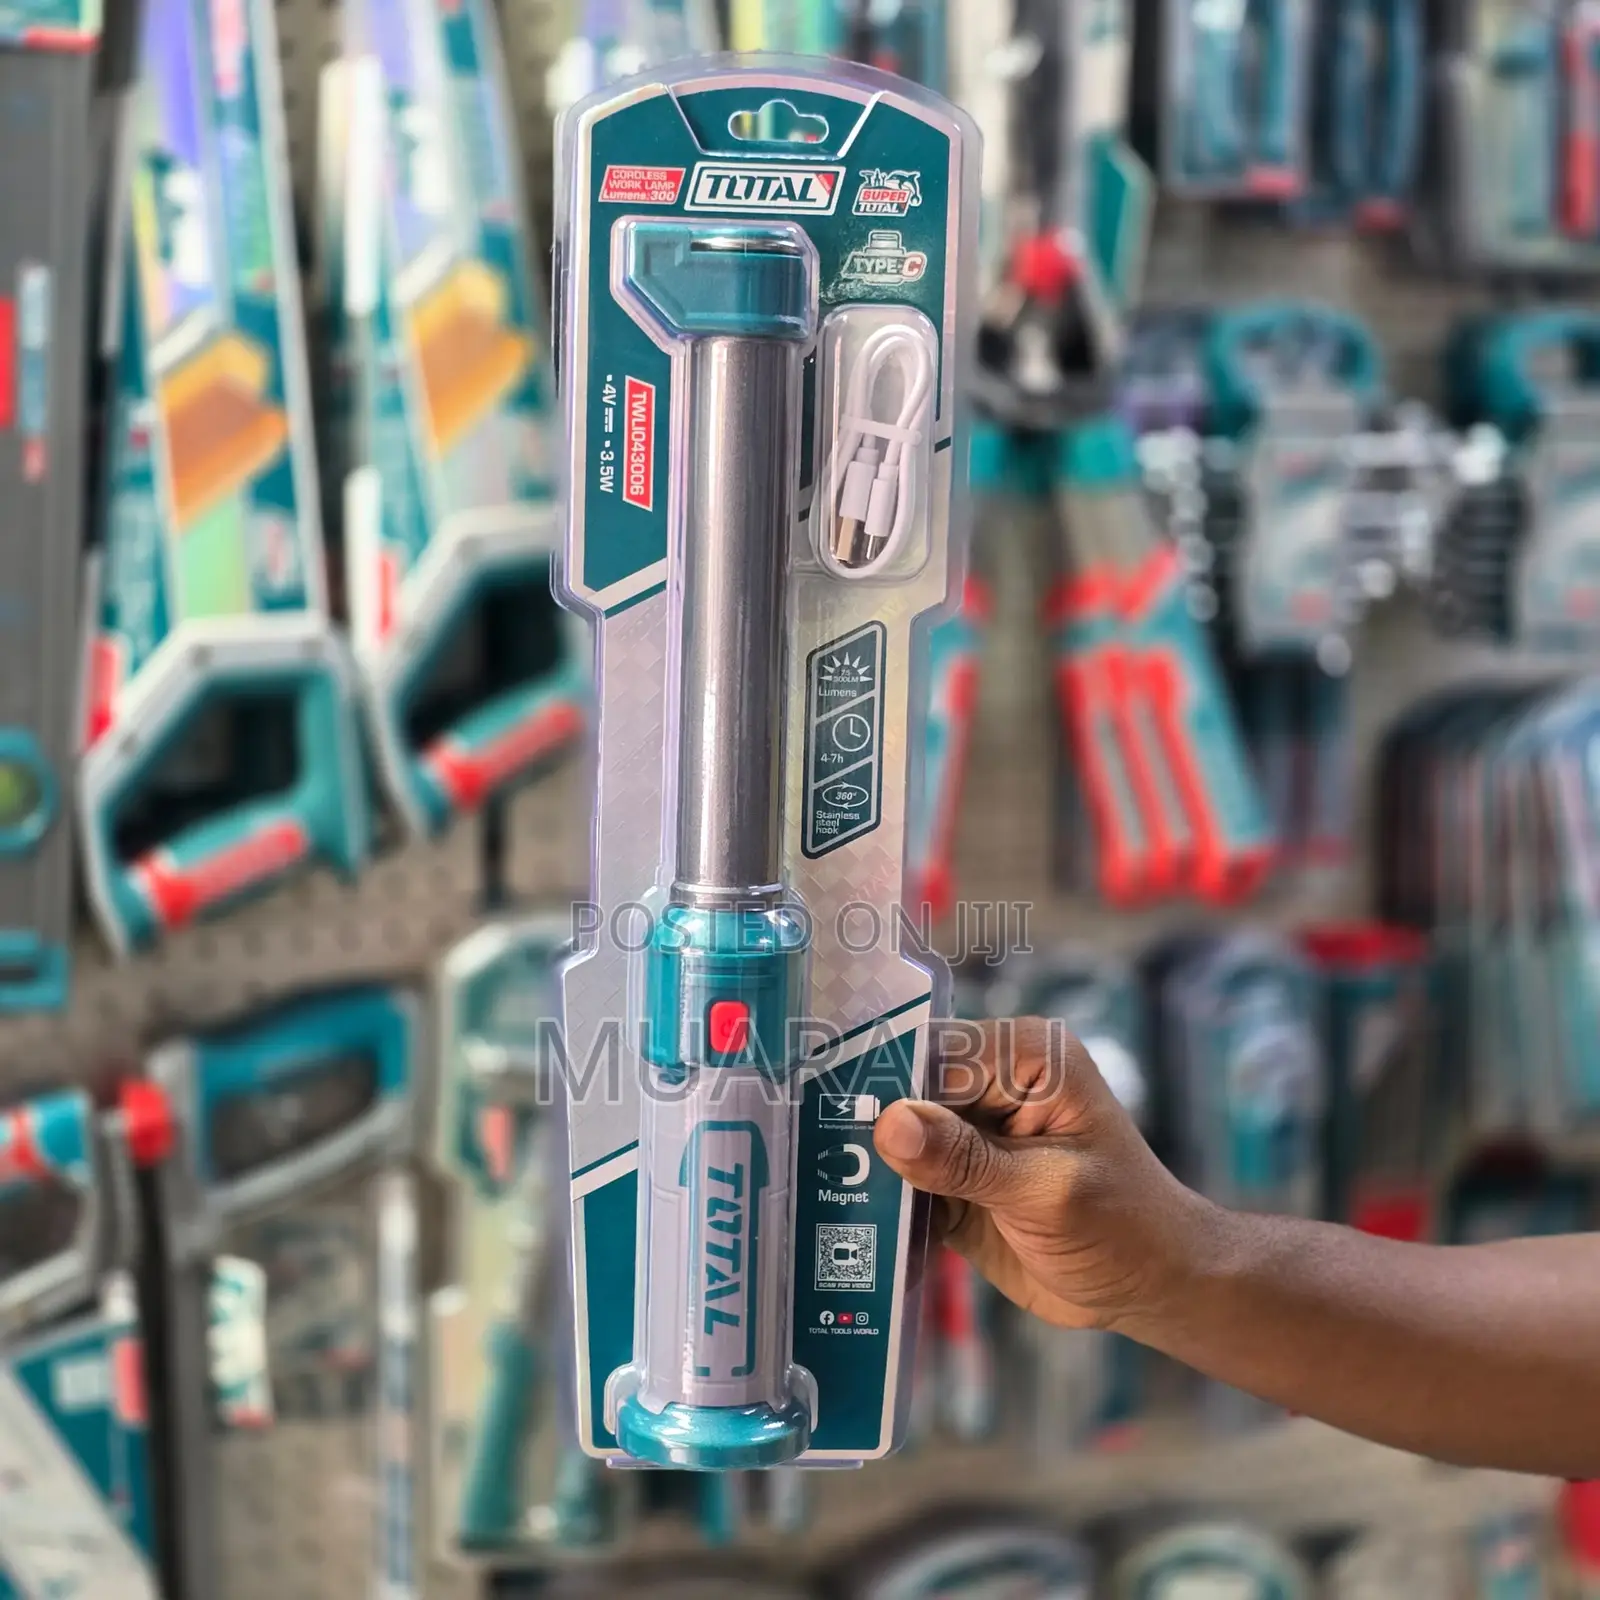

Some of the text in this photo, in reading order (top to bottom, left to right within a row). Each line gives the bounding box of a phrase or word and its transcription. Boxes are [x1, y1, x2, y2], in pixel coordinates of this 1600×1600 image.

[612, 169, 668, 181] CORDLESS
[609, 179, 676, 191] WORK LAMP
[706, 174, 818, 202] TOTAL
[861, 189, 908, 202] SUPER
[859, 202, 900, 213] TOTAL
[853, 255, 923, 277] TYPE-C
[599, 450, 615, 494] 3.5W
[818, 685, 858, 697] Lumens
[820, 753, 844, 764] 4-7h
[815, 810, 860, 821] Stainless
[815, 819, 840, 828] steel
[815, 826, 839, 835] hook
[818, 1188, 870, 1206] Magnet
[703, 1162, 745, 1337] TOTAL
[851, 1282, 872, 1290] VIDEO
[808, 1327, 879, 1336] TOTAL TOOLS WORLD
